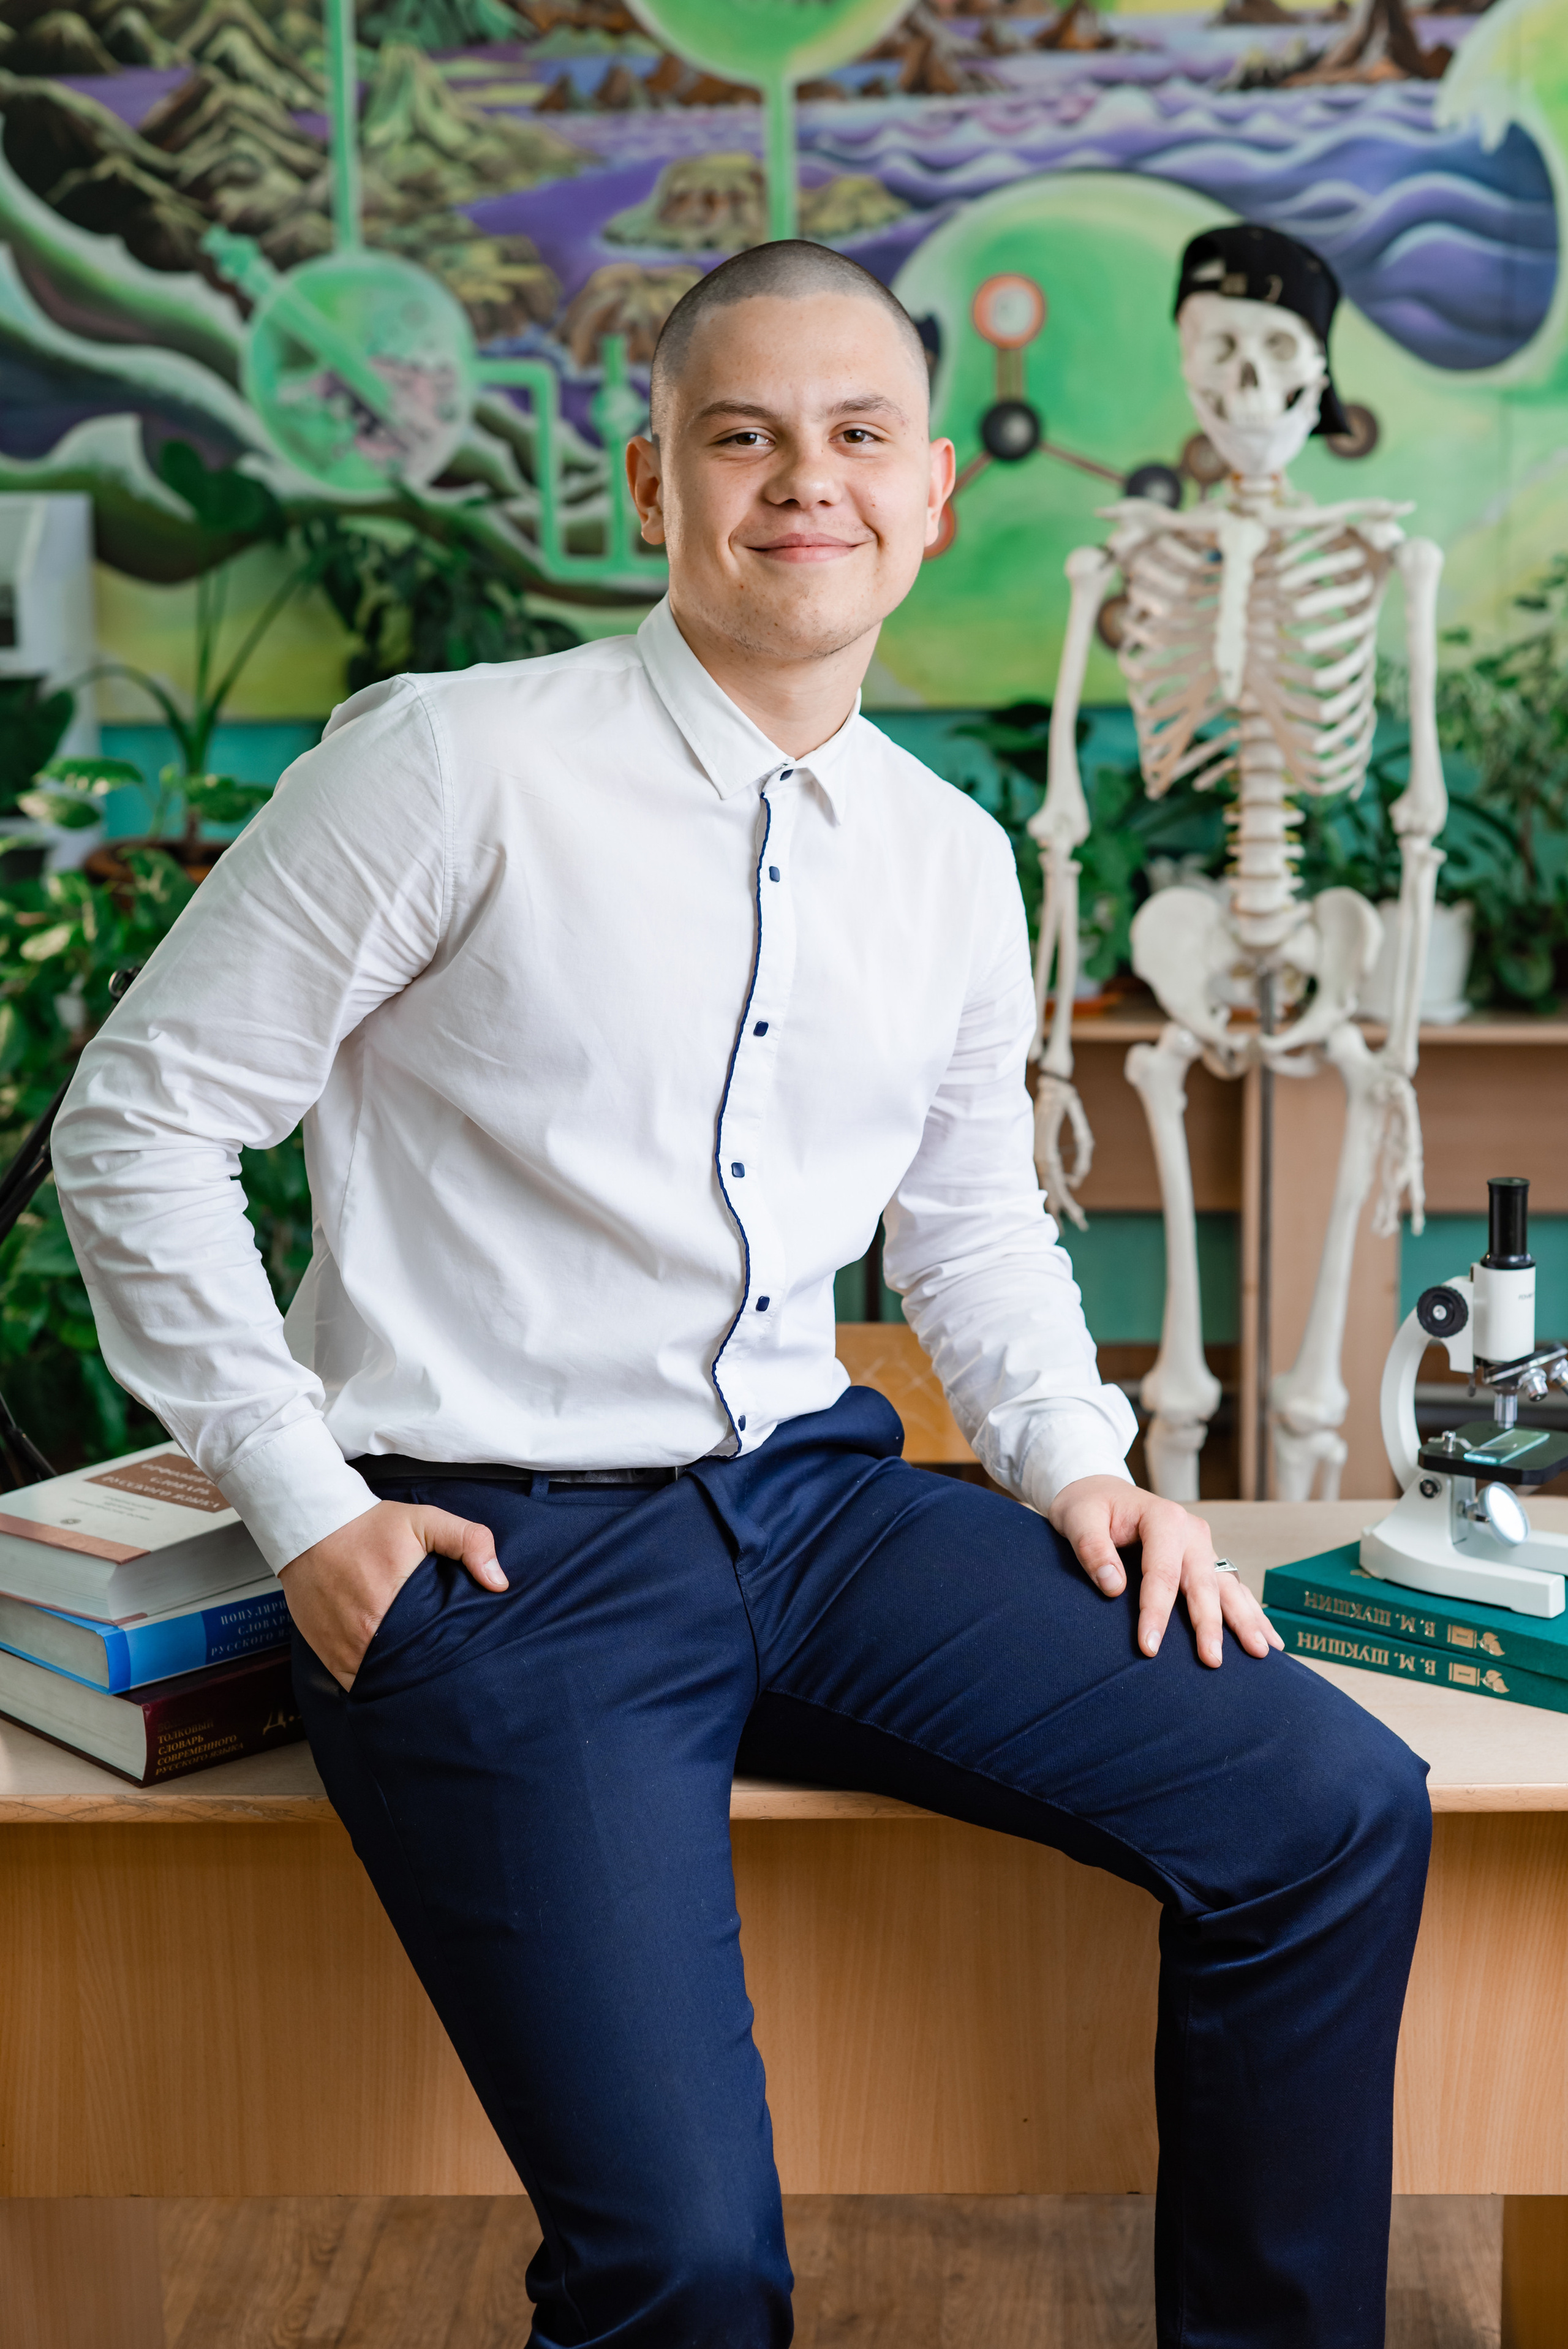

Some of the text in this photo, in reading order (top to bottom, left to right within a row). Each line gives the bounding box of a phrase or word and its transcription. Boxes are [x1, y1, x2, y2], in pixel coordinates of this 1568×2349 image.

[221, 1599, 287, 1625] ПОПУЛЯРН
[238, 1614, 292, 1635] СЛОВАРЬ
[1304, 1591, 1436, 1638] В. М. ШУКШИН
[211, 1632, 274, 1657] РУССКОГО
[1297, 1632, 1436, 1676] В. М. ШУКШИН
[157, 1718, 214, 1744] ТОЛКОВЫЙ
[157, 1734, 237, 1766] СОВРЕМЕННОГО
[158, 1734, 204, 1755] СЛОВАРЬ
[156, 1742, 244, 1776] РУССКОГО ЯЗЫКА
